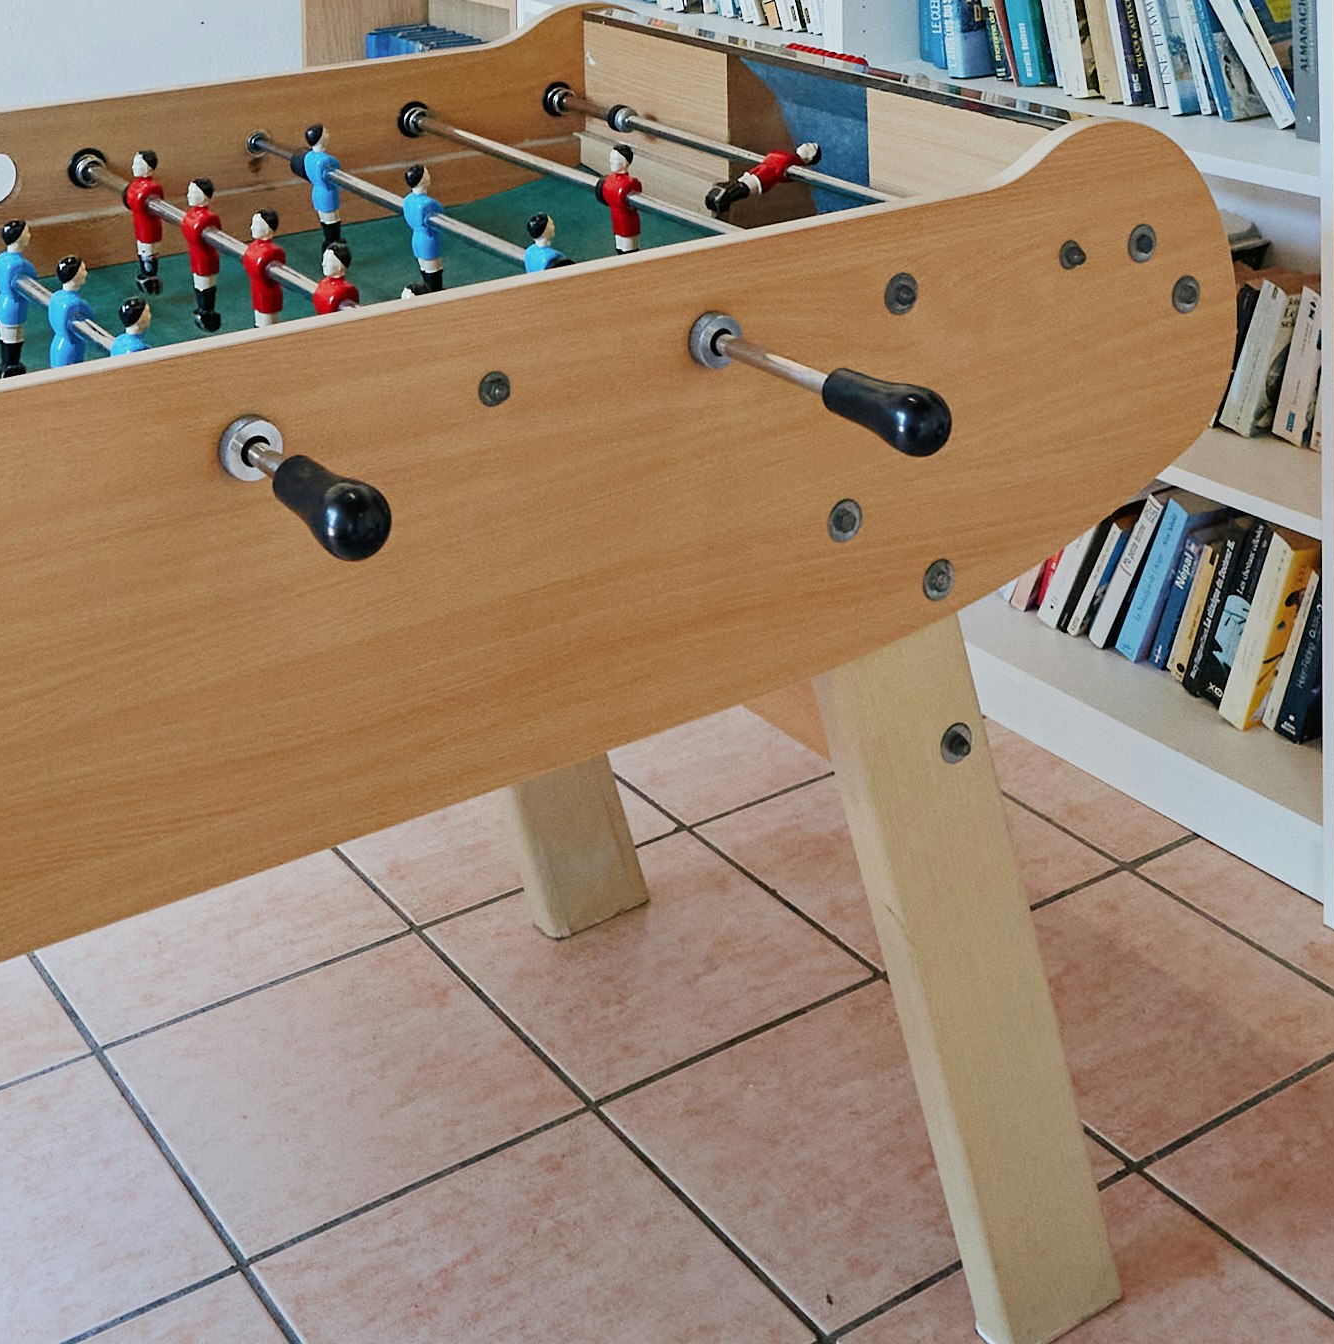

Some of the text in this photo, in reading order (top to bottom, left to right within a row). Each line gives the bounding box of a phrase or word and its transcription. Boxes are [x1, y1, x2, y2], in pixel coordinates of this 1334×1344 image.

[931, 22, 942, 34] LE
[1132, 40, 1144, 68] TRUCS
[1160, 56, 1172, 85] UNE
[1174, 553, 1194, 589] Népal
